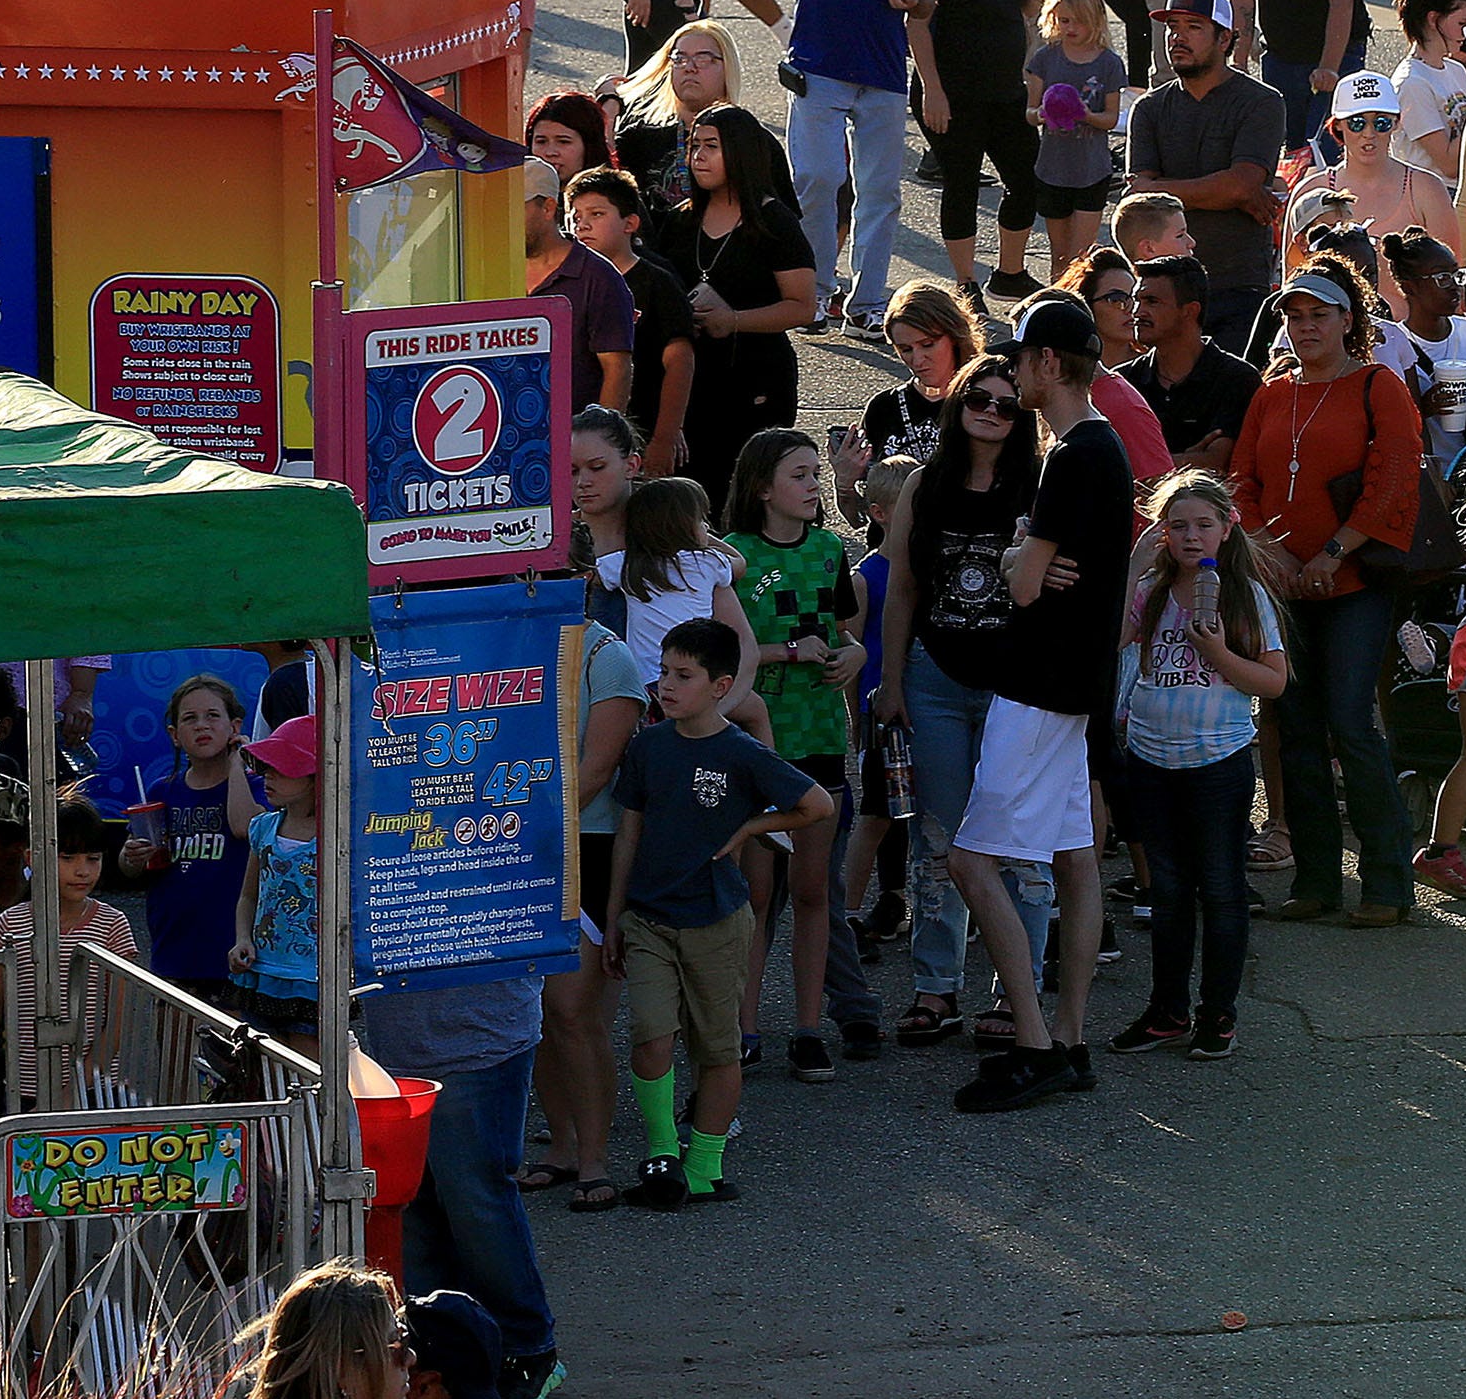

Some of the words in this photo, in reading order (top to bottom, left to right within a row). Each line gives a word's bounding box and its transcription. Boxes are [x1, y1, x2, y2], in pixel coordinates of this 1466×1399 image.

[1353, 78, 1379, 86] LIONS
[1357, 85, 1375, 93] NOT
[112, 290, 197, 315] RAINY
[201, 292, 259, 316] DAY
[119, 322, 146, 337] BUY
[147, 323, 230, 338] WRISTBANDS
[130, 339, 165, 353] YOUR
[167, 340, 200, 353] OWN
[202, 341, 230, 354] RISK
[377, 336, 420, 358] THIS
[426, 332, 471, 354] RIDE
[477, 326, 539, 350] TAKES
[122, 356, 150, 368] Some
[151, 356, 176, 369] rides
[122, 369, 153, 381] Shows
[154, 370, 188, 383] subject
[112, 386, 133, 400] NO
[199, 388, 261, 403] REBANDS
[153, 404, 239, 418] RAINCHECKS
[431, 374, 487, 462] 2
[171, 424, 225, 436] responsible
[404, 475, 512, 514] TICKETS
[380, 529, 417, 551] GOING
[418, 528, 433, 542] TO
[434, 524, 467, 544] MAKE
[467, 528, 492, 544] YOU
[493, 514, 538, 537] SMILE!
[1154, 670, 1212, 689] VIBES
[370, 675, 452, 721] SIZE
[456, 666, 544, 712] WIZE
[426, 775, 451, 787] MUST
[447, 794, 475, 806] ALONE
[364, 808, 434, 835] Jumping
[409, 827, 448, 852] Jack
[44, 1137, 107, 1168] DO
[120, 1131, 210, 1164] NOT
[59, 1173, 196, 1208] ENTER
